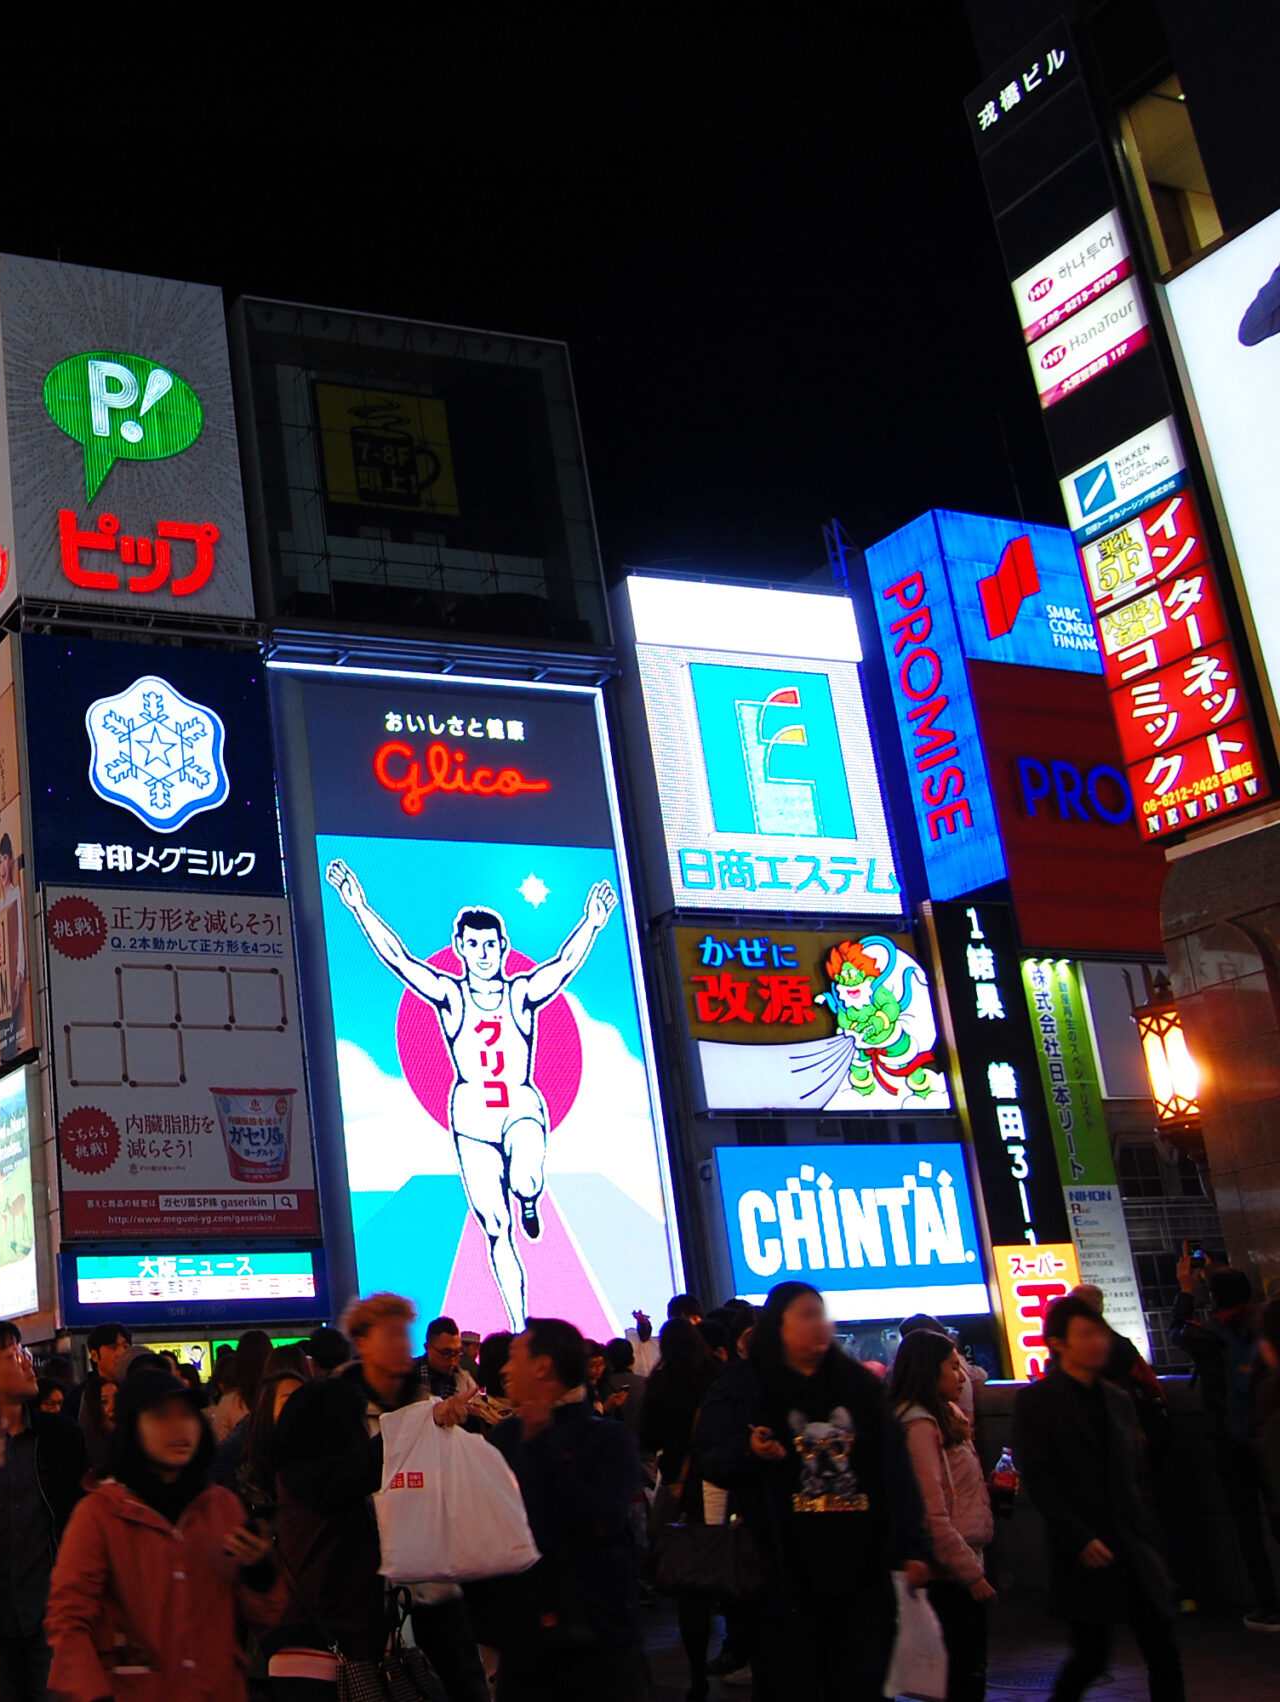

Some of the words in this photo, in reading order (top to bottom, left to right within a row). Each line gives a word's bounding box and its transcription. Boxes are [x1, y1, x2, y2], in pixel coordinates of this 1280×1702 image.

[977, 49, 1066, 131] 戎橋ビル
[1058, 232, 1114, 279] 하나투어
[1069, 299, 1135, 351] HanaTour
[1114, 443, 1150, 468] NIKKEN
[1118, 457, 1148, 478] TOTAL
[1120, 456, 1170, 489] SOURCING
[58, 509, 220, 596] ピップ
[1096, 541, 1144, 592] 5F
[1046, 604, 1083, 622] SMBC
[1106, 598, 1150, 635] 入口は
[1146, 497, 1245, 774] インターネット
[882, 570, 974, 842] PROMISE
[1117, 638, 1184, 797] コミック
[385, 711, 526, 741] おいしさと健康
[374, 740, 552, 815] Glico
[1142, 774, 1220, 815] 06-6212-2423
[74, 842, 257, 877] 雪印メグミルク
[52, 917, 101, 939] 挑戦!
[111, 905, 283, 936] 正方形を減らそう!
[698, 935, 800, 969] かぜに
[691, 972, 817, 1025] 改源
[474, 1015, 510, 1108] グリコ
[1032, 966, 1086, 1181] 株式会社日本リート
[66, 1124, 111, 1141] こちらも
[125, 1114, 215, 1135] 内臓脂肪を
[73, 1141, 109, 1158] 挑戦!
[126, 1139, 193, 1159] 減らそう!
[244, 1148, 274, 1157] ヨーグルト
[220, 1198, 267, 1210] gaserikin
[1069, 1190, 1112, 1202] NIHON
[108, 1214, 276, 1225] http://www.megumi-yg.com/gaserikin/
[137, 1256, 254, 1279] 大阪ニュース
[1010, 1256, 1065, 1275] スーパー
